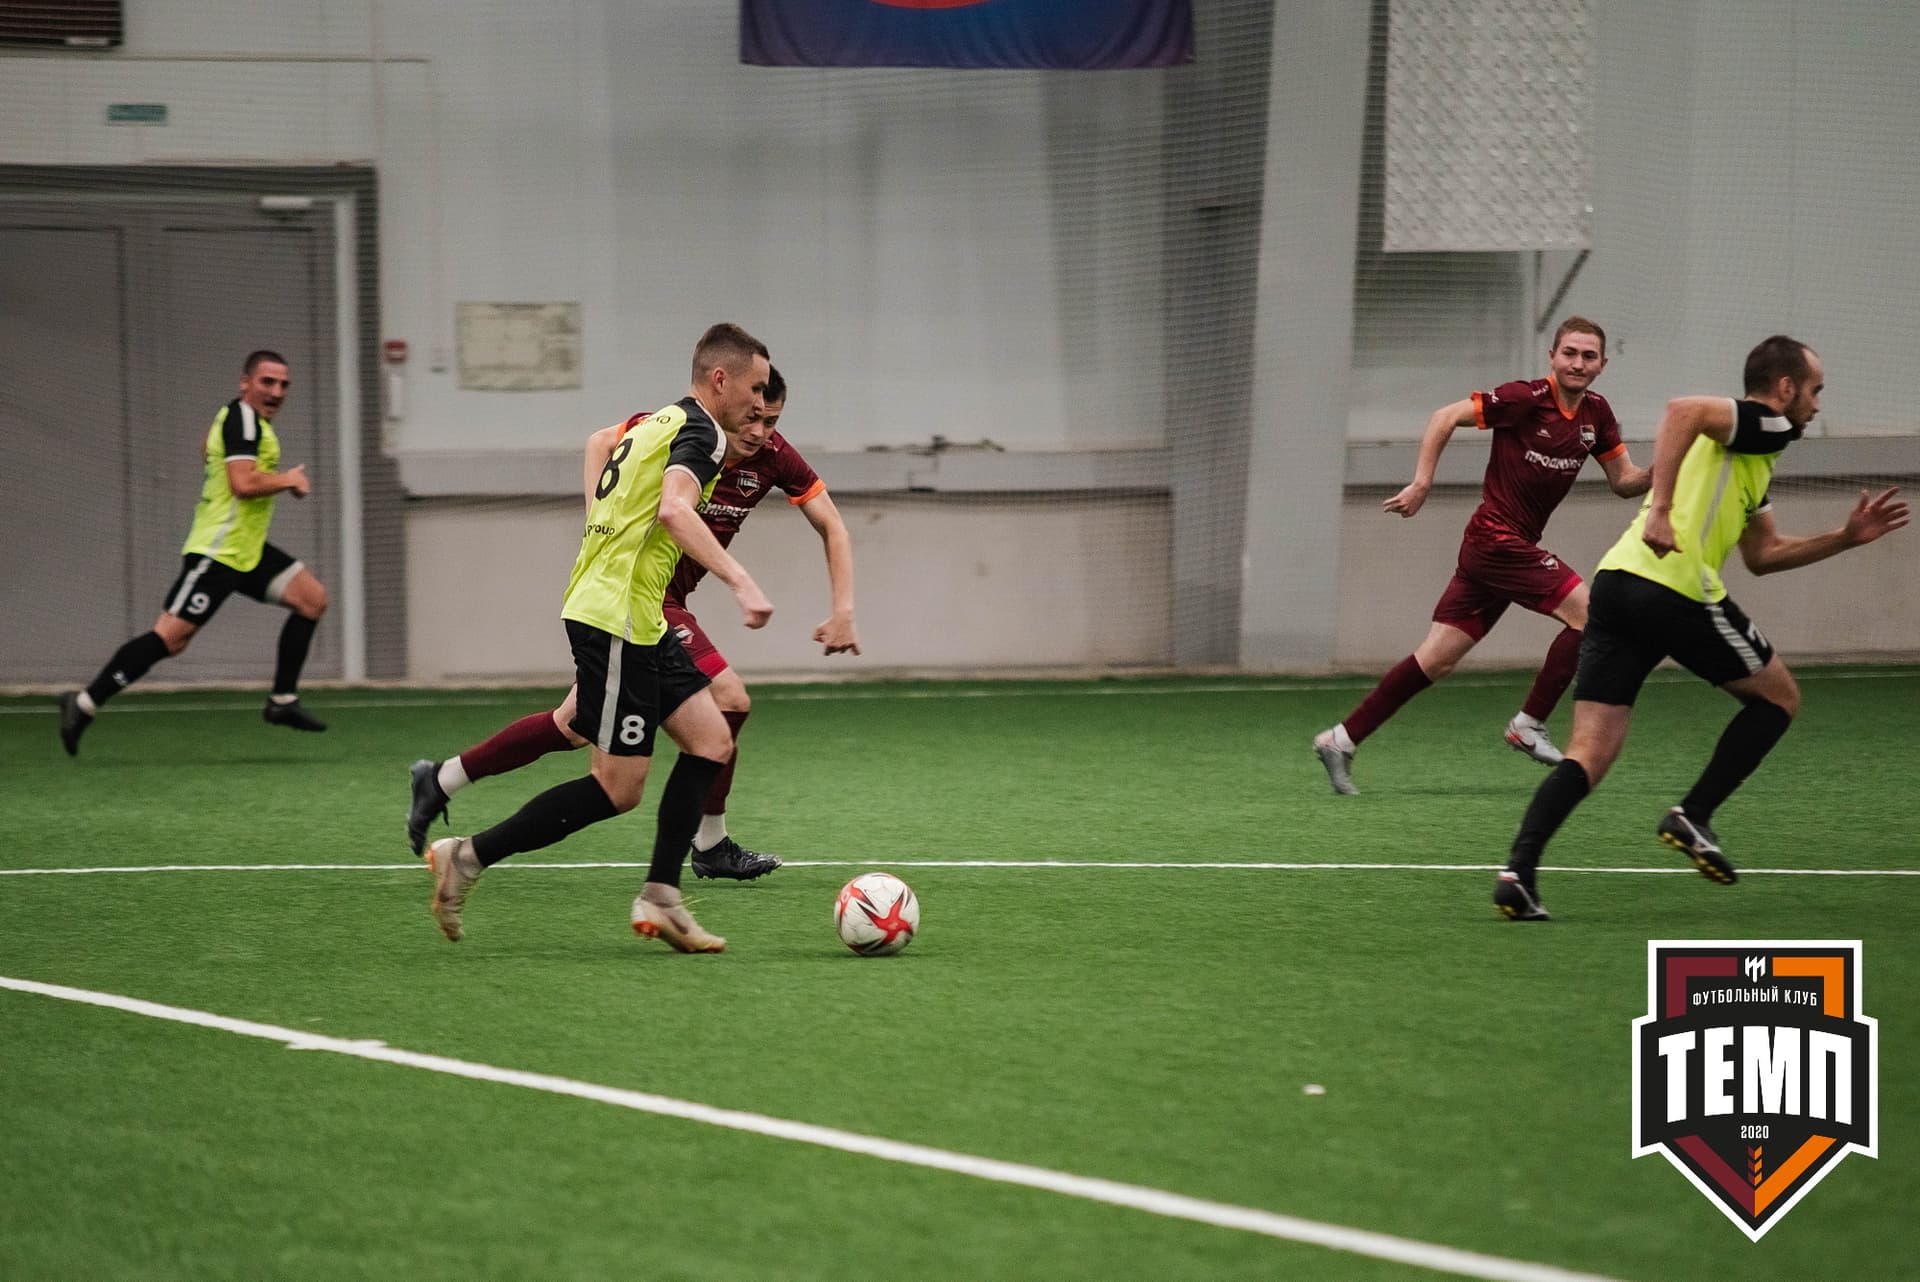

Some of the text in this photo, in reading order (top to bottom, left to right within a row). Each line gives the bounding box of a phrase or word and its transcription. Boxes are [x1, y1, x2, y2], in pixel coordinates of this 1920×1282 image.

[594, 438, 633, 501] 8
[187, 592, 210, 614] 9
[619, 715, 645, 745] 8
